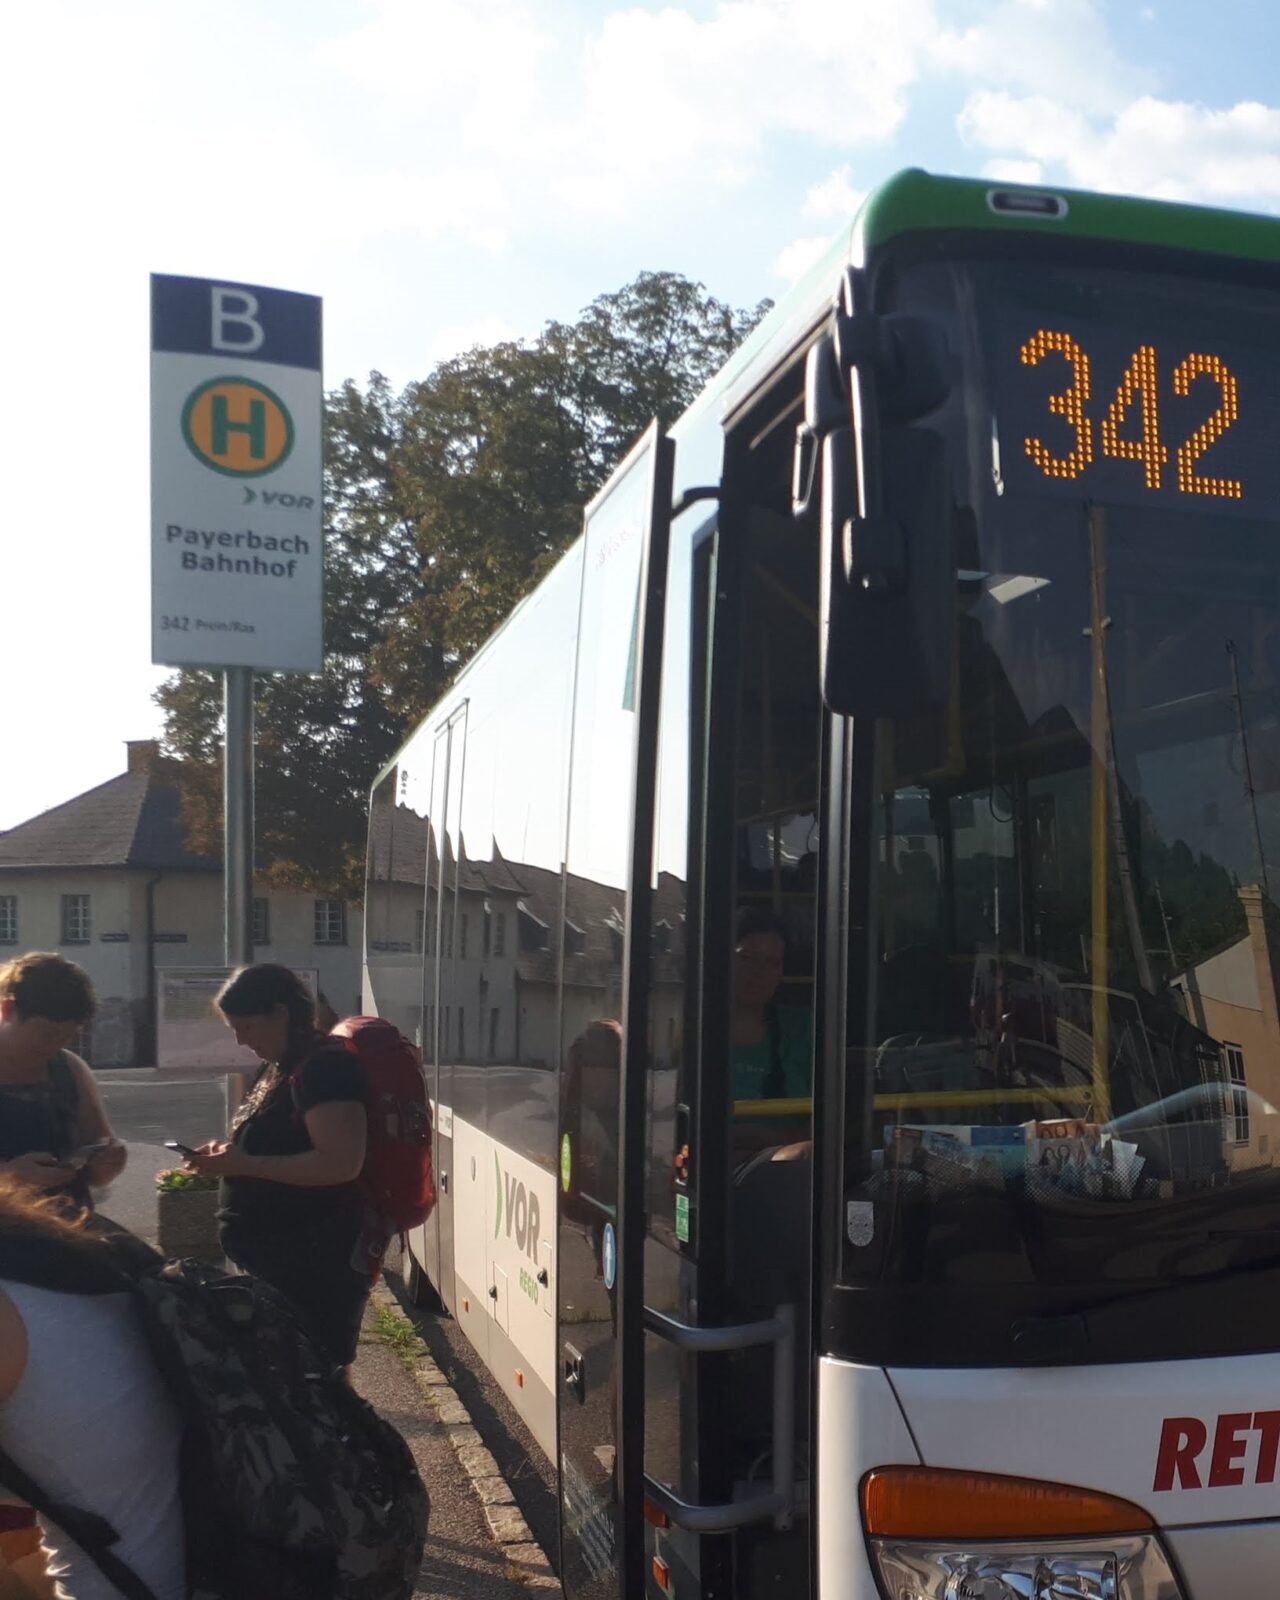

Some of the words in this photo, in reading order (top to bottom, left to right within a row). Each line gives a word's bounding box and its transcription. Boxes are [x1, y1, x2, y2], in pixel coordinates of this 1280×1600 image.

[210, 286, 265, 353] B
[211, 394, 266, 460] H
[1019, 328, 1242, 499] 342
[261, 490, 314, 510] VOR
[166, 525, 310, 556] Payerbach
[181, 551, 298, 579] Bahnhof
[161, 615, 190, 632] 342
[504, 1171, 540, 1266] VOR
